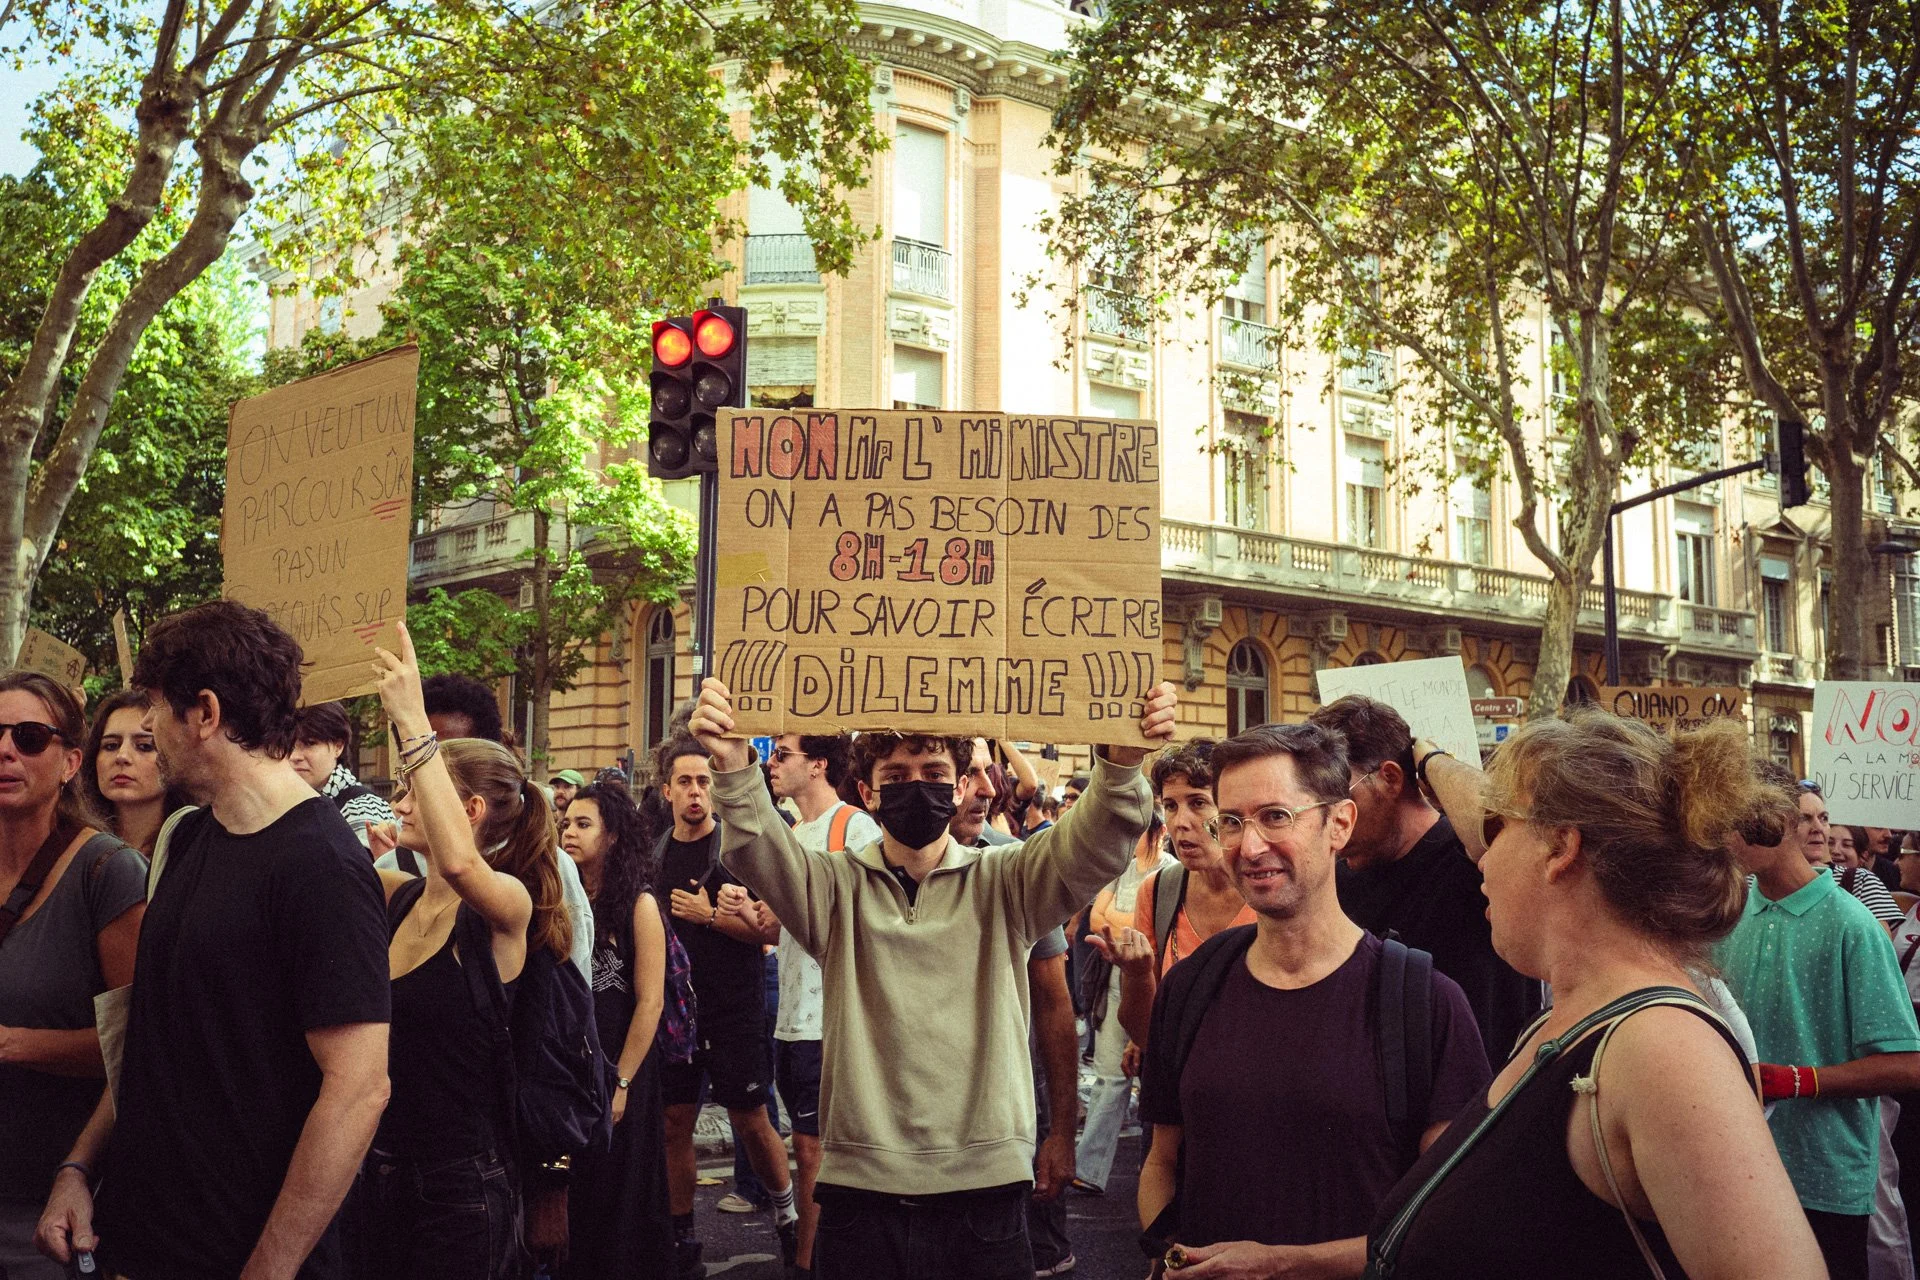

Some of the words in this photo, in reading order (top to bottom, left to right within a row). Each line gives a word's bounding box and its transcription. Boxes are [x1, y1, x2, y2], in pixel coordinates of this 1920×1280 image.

[239, 410, 297, 485] ON
[305, 399, 376, 458] VEUT
[376, 389, 411, 434] UN
[730, 412, 839, 480] NON
[745, 488, 796, 530] ON
[818, 492, 842, 527] A
[865, 492, 915, 530] PAS
[930, 495, 1067, 536] BESOIN
[1087, 504, 1151, 541] DES
[742, 586, 840, 635] POUR
[850, 592, 995, 638] SAVOIR
[1022, 577, 1161, 639] ÉCRIRE
[1401, 686, 1425, 710] LE
[1474, 703, 1501, 712] Centre
[1613, 690, 1690, 719] QUAND
[1702, 692, 1737, 717] ON
[1825, 688, 1920, 748] NO
[1834, 752, 1853, 765] A
[1866, 753, 1887, 765] LA
[1815, 771, 1837, 800] DU
